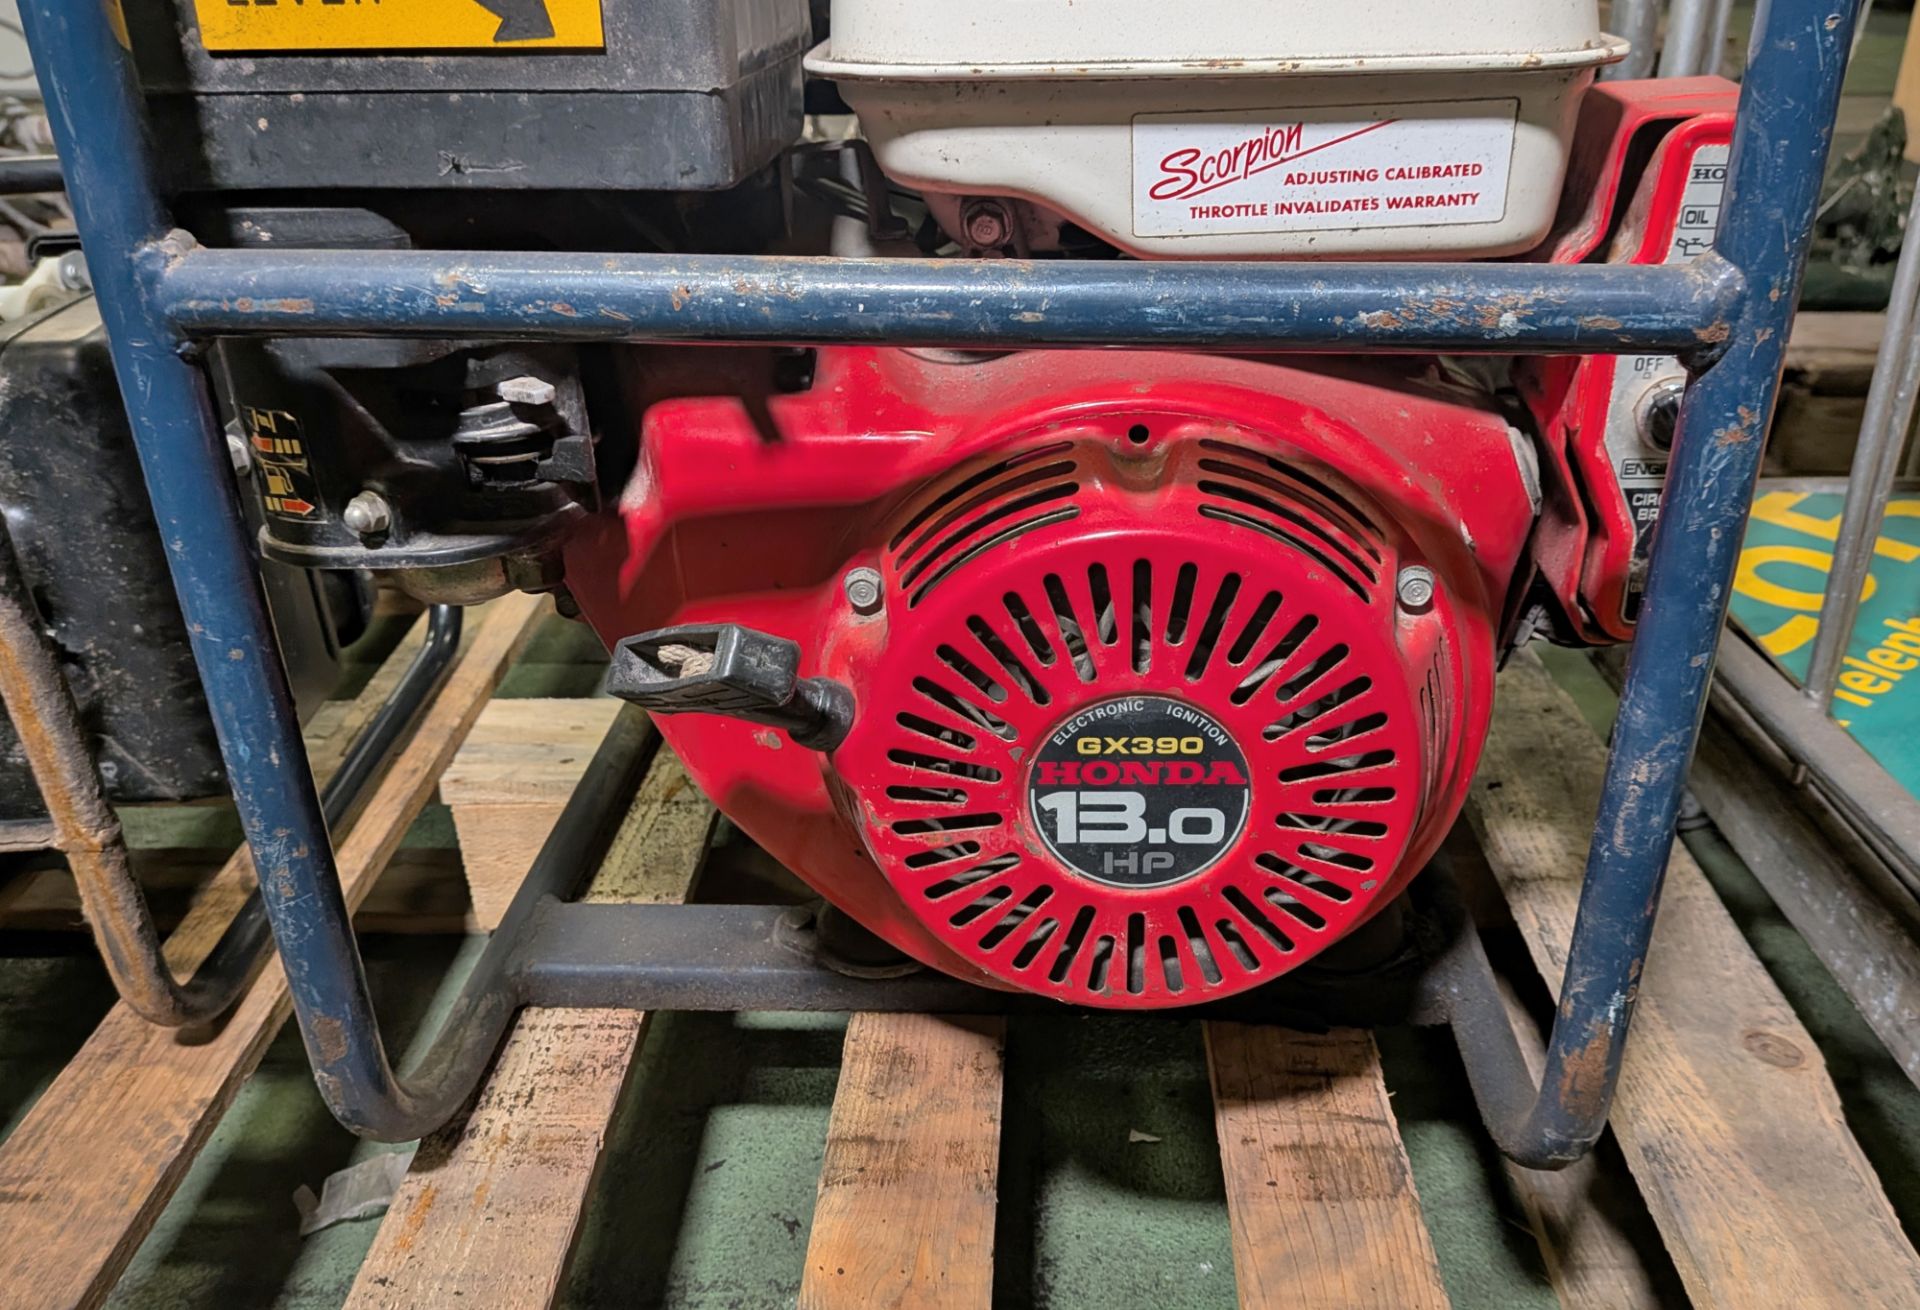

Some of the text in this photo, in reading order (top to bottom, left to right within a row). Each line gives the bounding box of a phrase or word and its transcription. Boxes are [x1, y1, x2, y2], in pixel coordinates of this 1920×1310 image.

[1149, 121, 1304, 200] Scorpion
[1284, 163, 1483, 186] ADJUSTING CALIBRATED
[1189, 192, 1480, 219] THROTTLE INVALIDATES WARRANTY
[1685, 210, 1709, 224] OIL
[1634, 357, 1664, 372] OFF
[1052, 699, 1229, 747] ELECTRONIC IGNITION
[1076, 736, 1204, 755] GX390
[1037, 761, 1248, 786] HONDA
[1038, 791, 1226, 844] 13.0
[1103, 851, 1175, 875] HP
